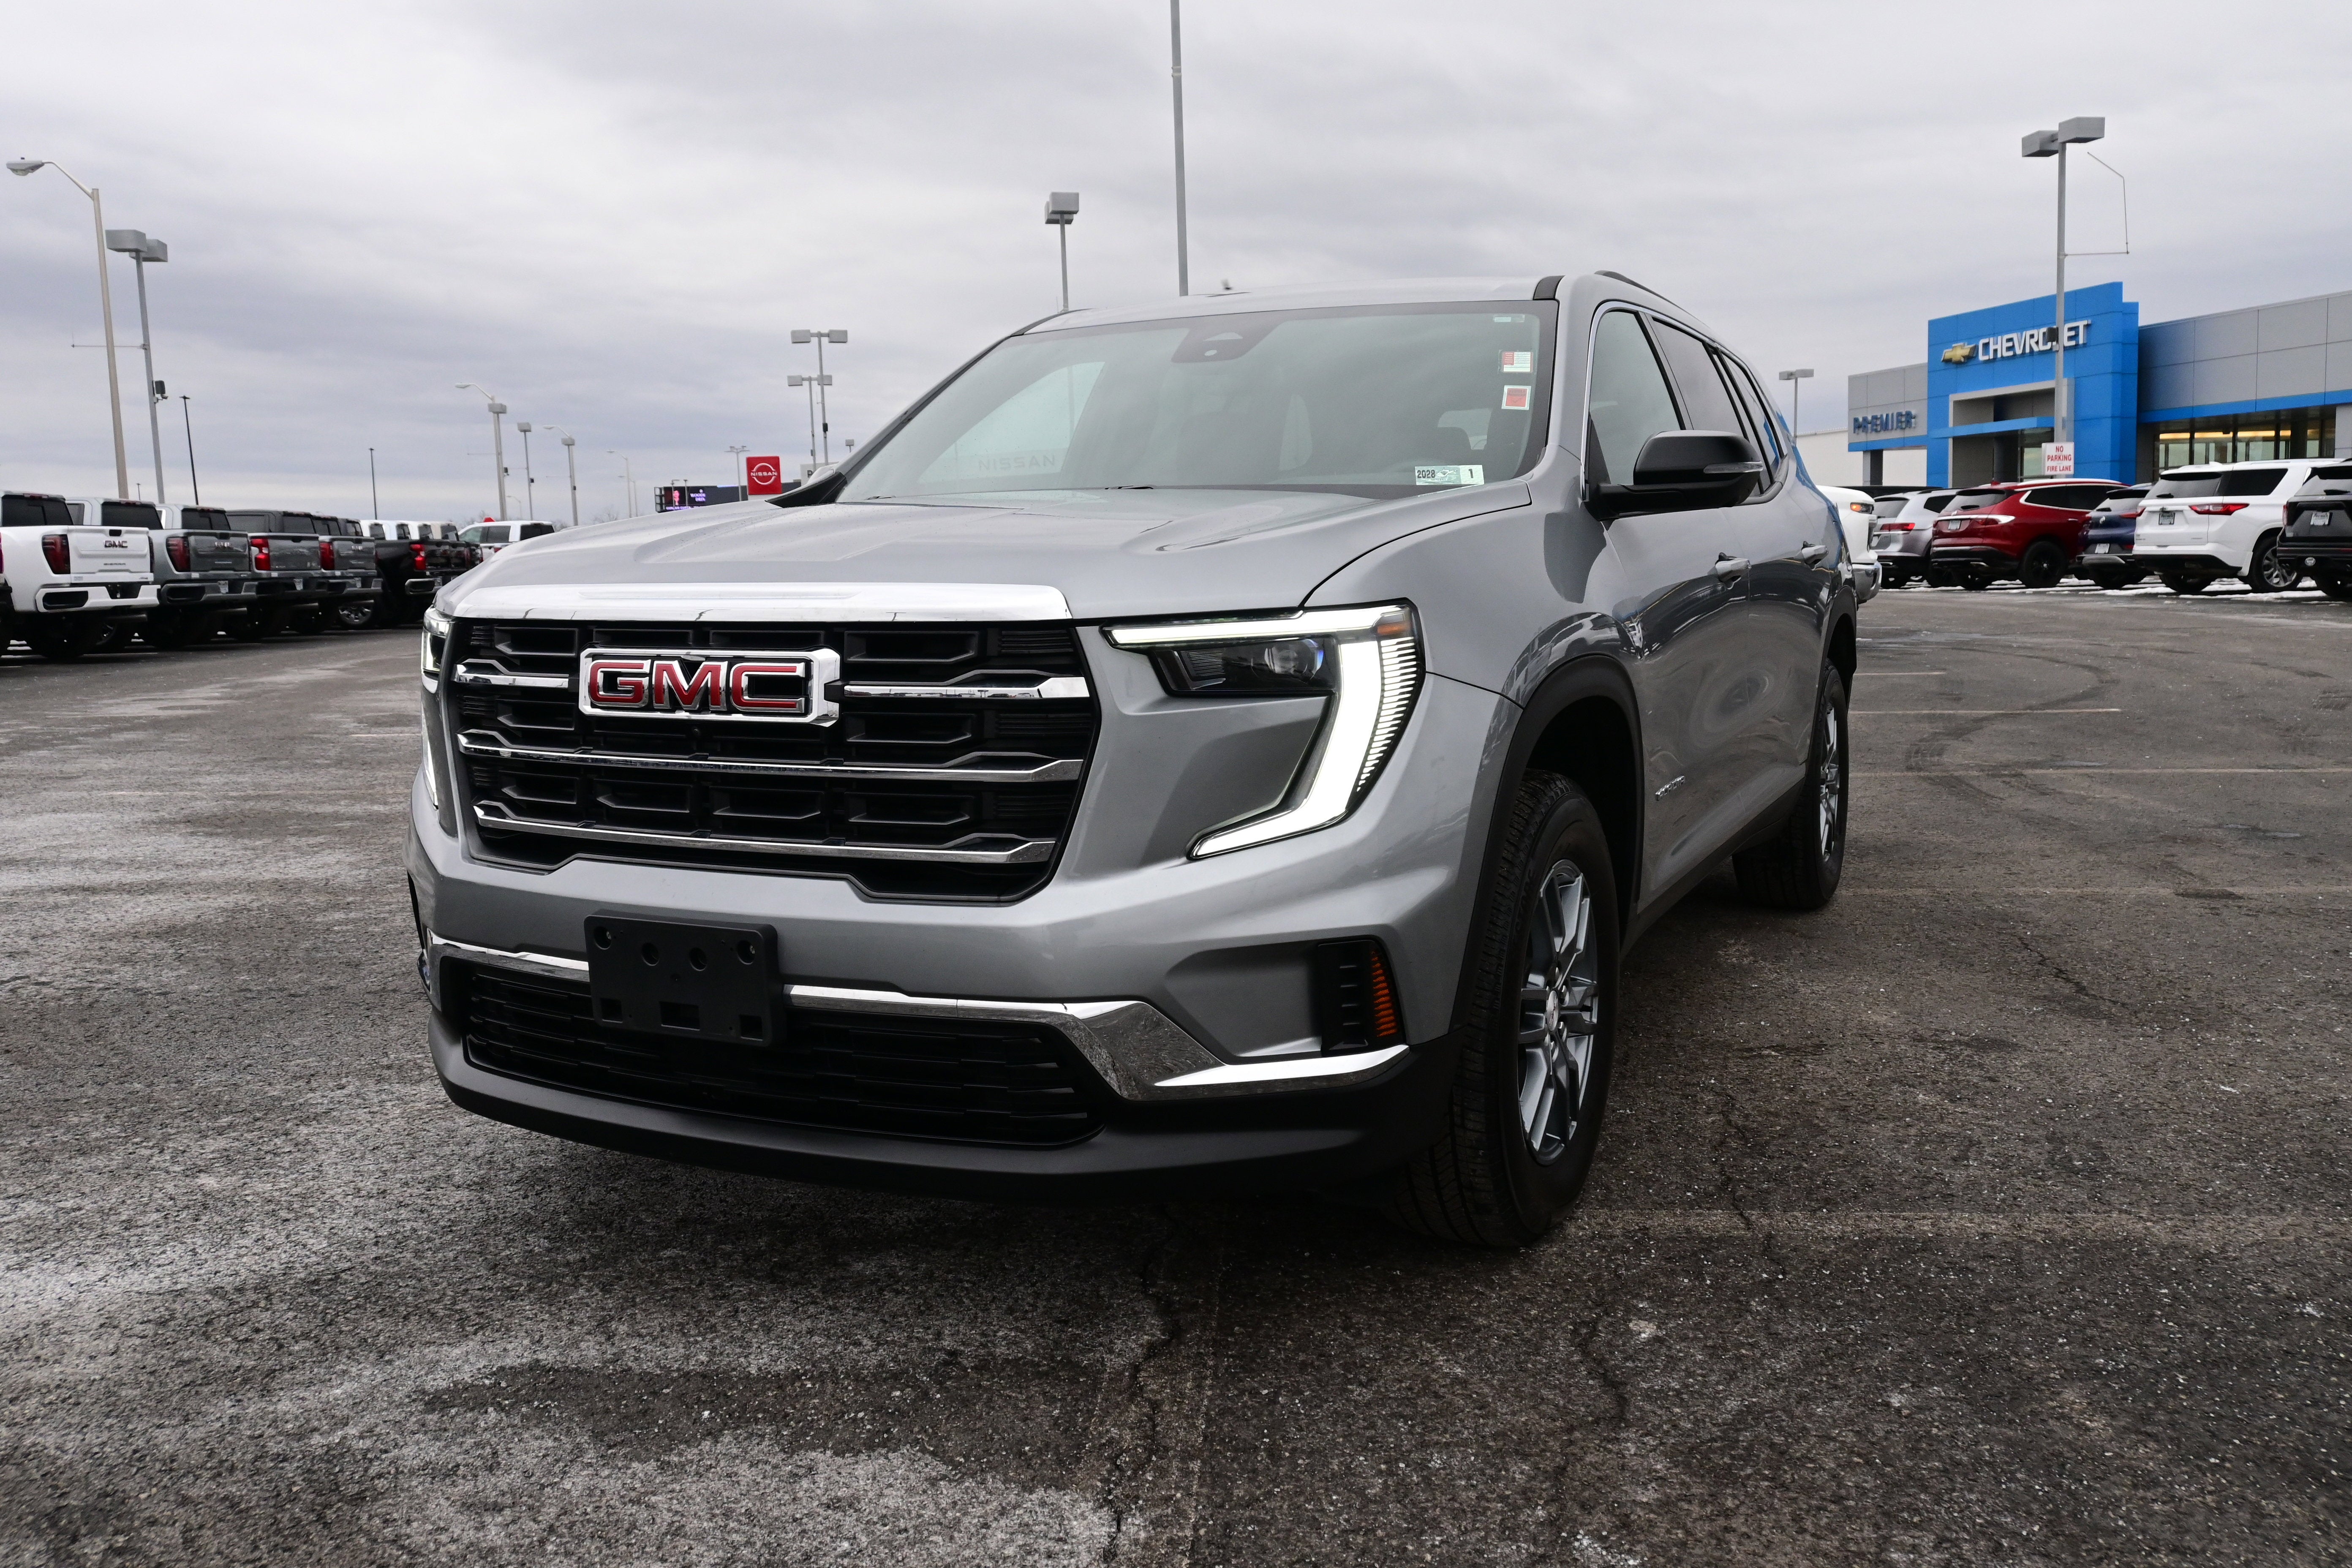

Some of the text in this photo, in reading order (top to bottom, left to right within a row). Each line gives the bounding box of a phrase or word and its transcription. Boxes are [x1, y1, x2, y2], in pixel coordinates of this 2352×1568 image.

[1979, 319, 2091, 361] CHEVROET
[1853, 411, 1914, 434] PREMIER
[978, 455, 1056, 471] NISSAN
[1417, 468, 1474, 479] 2028 1
[588, 659, 805, 713] GMC
